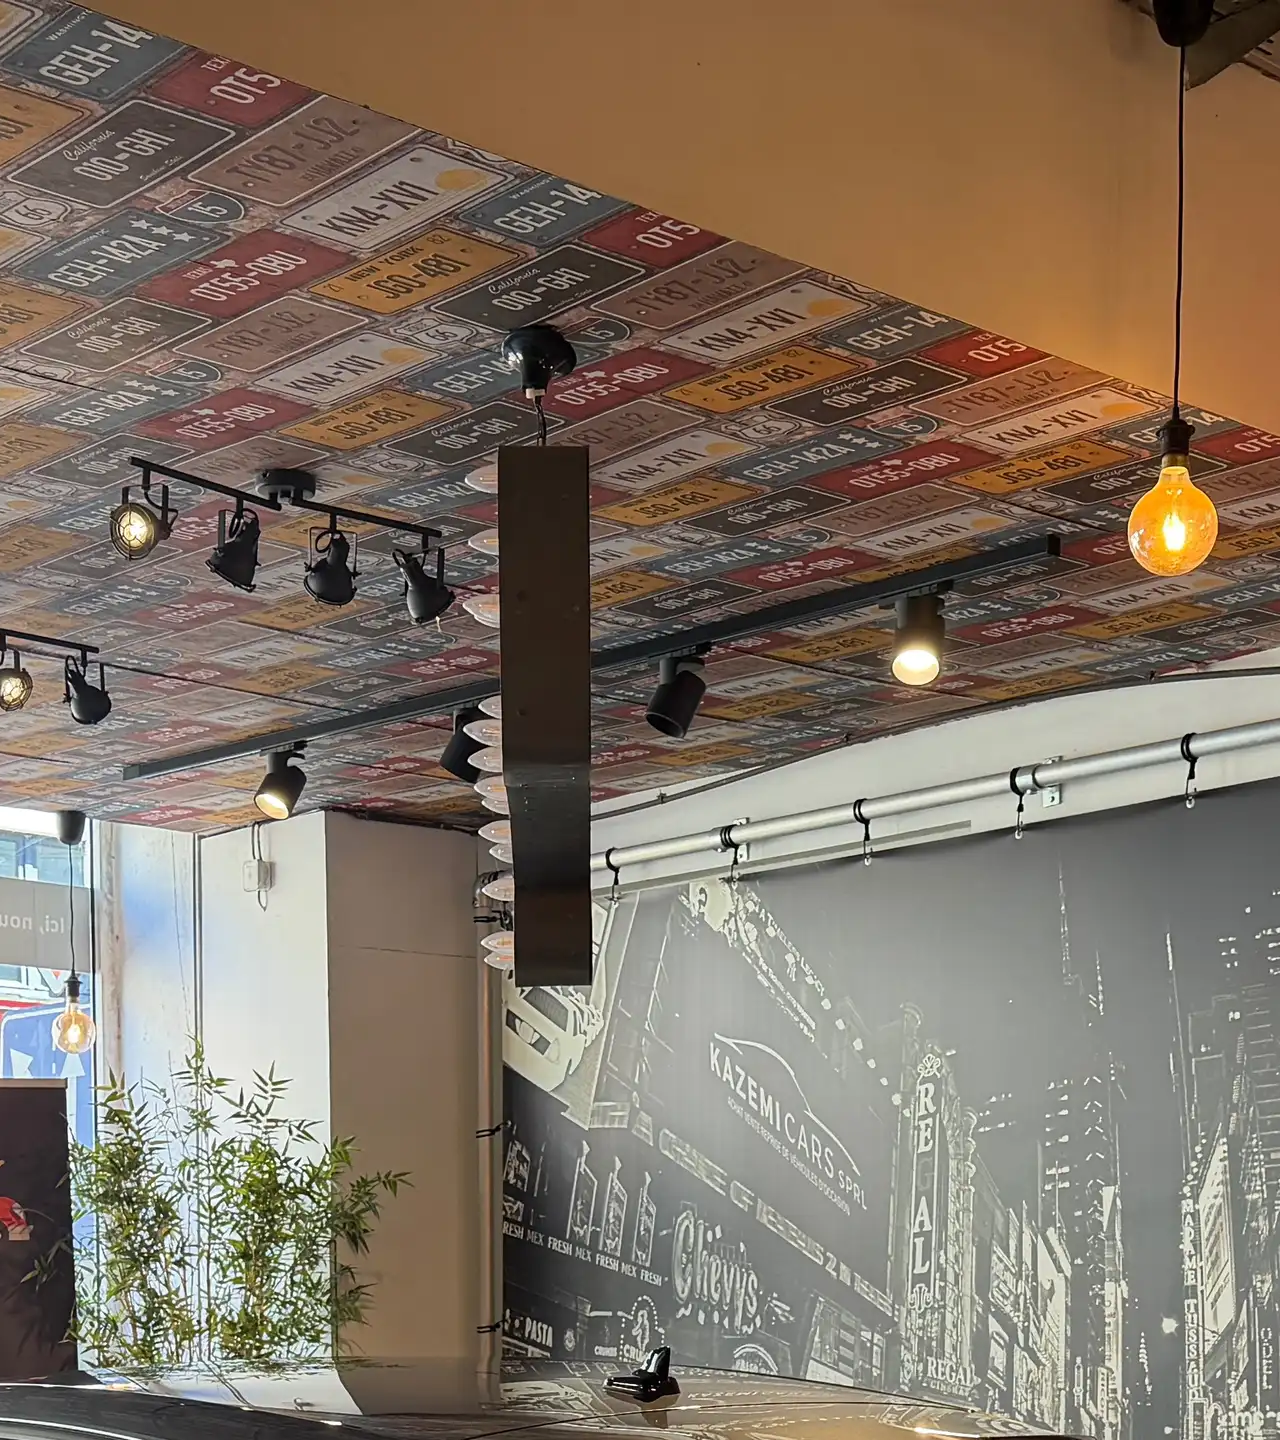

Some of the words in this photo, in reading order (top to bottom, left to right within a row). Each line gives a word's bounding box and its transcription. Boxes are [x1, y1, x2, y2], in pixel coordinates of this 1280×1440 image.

[39, 20, 154, 87] GEH-14
[494, 183, 603, 234] GEH-14
[847, 310, 950, 351] GEH-14
[710, 1042, 780, 1131] KAZEMI
[785, 1113, 834, 1178] CARS
[838, 1170, 867, 1210] SPRL
[503, 1221, 523, 1239] RESH
[526, 1230, 545, 1246] MEX
[548, 1236, 572, 1256] FRESH
[575, 1246, 591, 1262] MEX
[596, 1253, 619, 1272] FRESH
[621, 1262, 637, 1278] MEX
[640, 1269, 662, 1287] FRESH
[524, 1317, 553, 1348] PASTA
